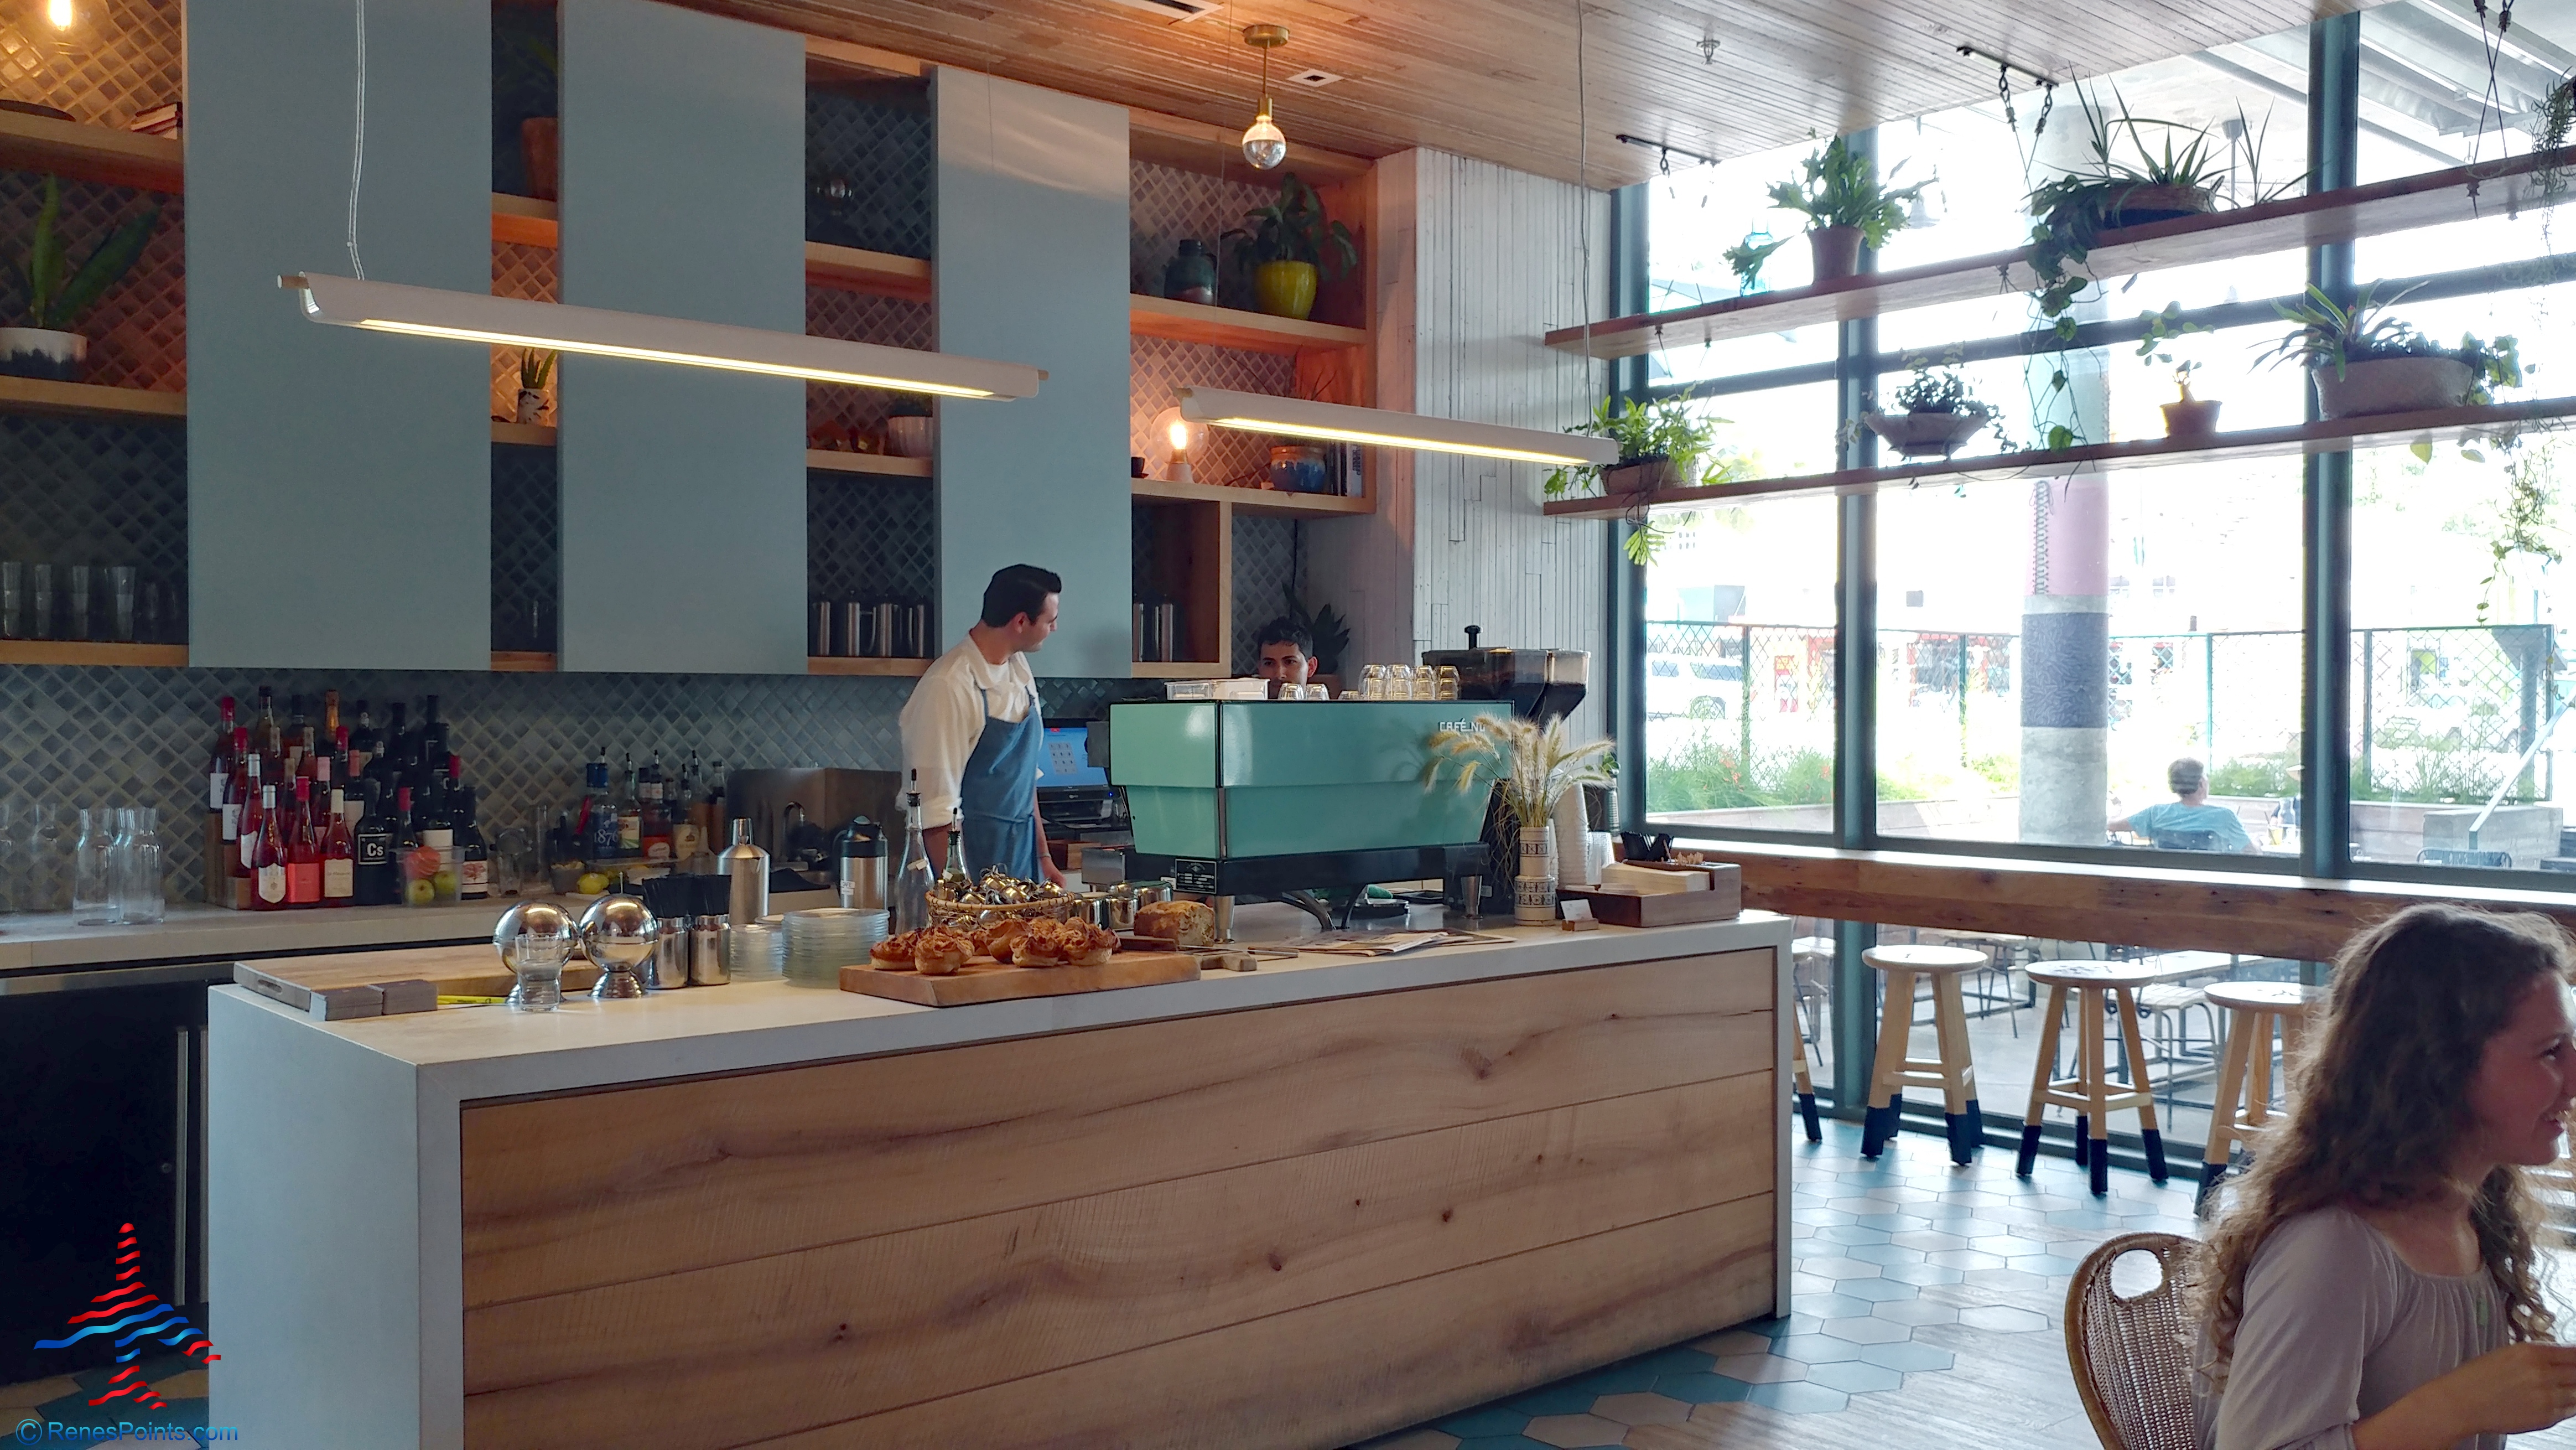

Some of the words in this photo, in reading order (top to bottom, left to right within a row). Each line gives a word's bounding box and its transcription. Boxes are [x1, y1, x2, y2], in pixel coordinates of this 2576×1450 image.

[1439, 717, 1466, 732] CAFÉ
[594, 828, 618, 846] 1876
[366, 842, 384, 857] Cs
